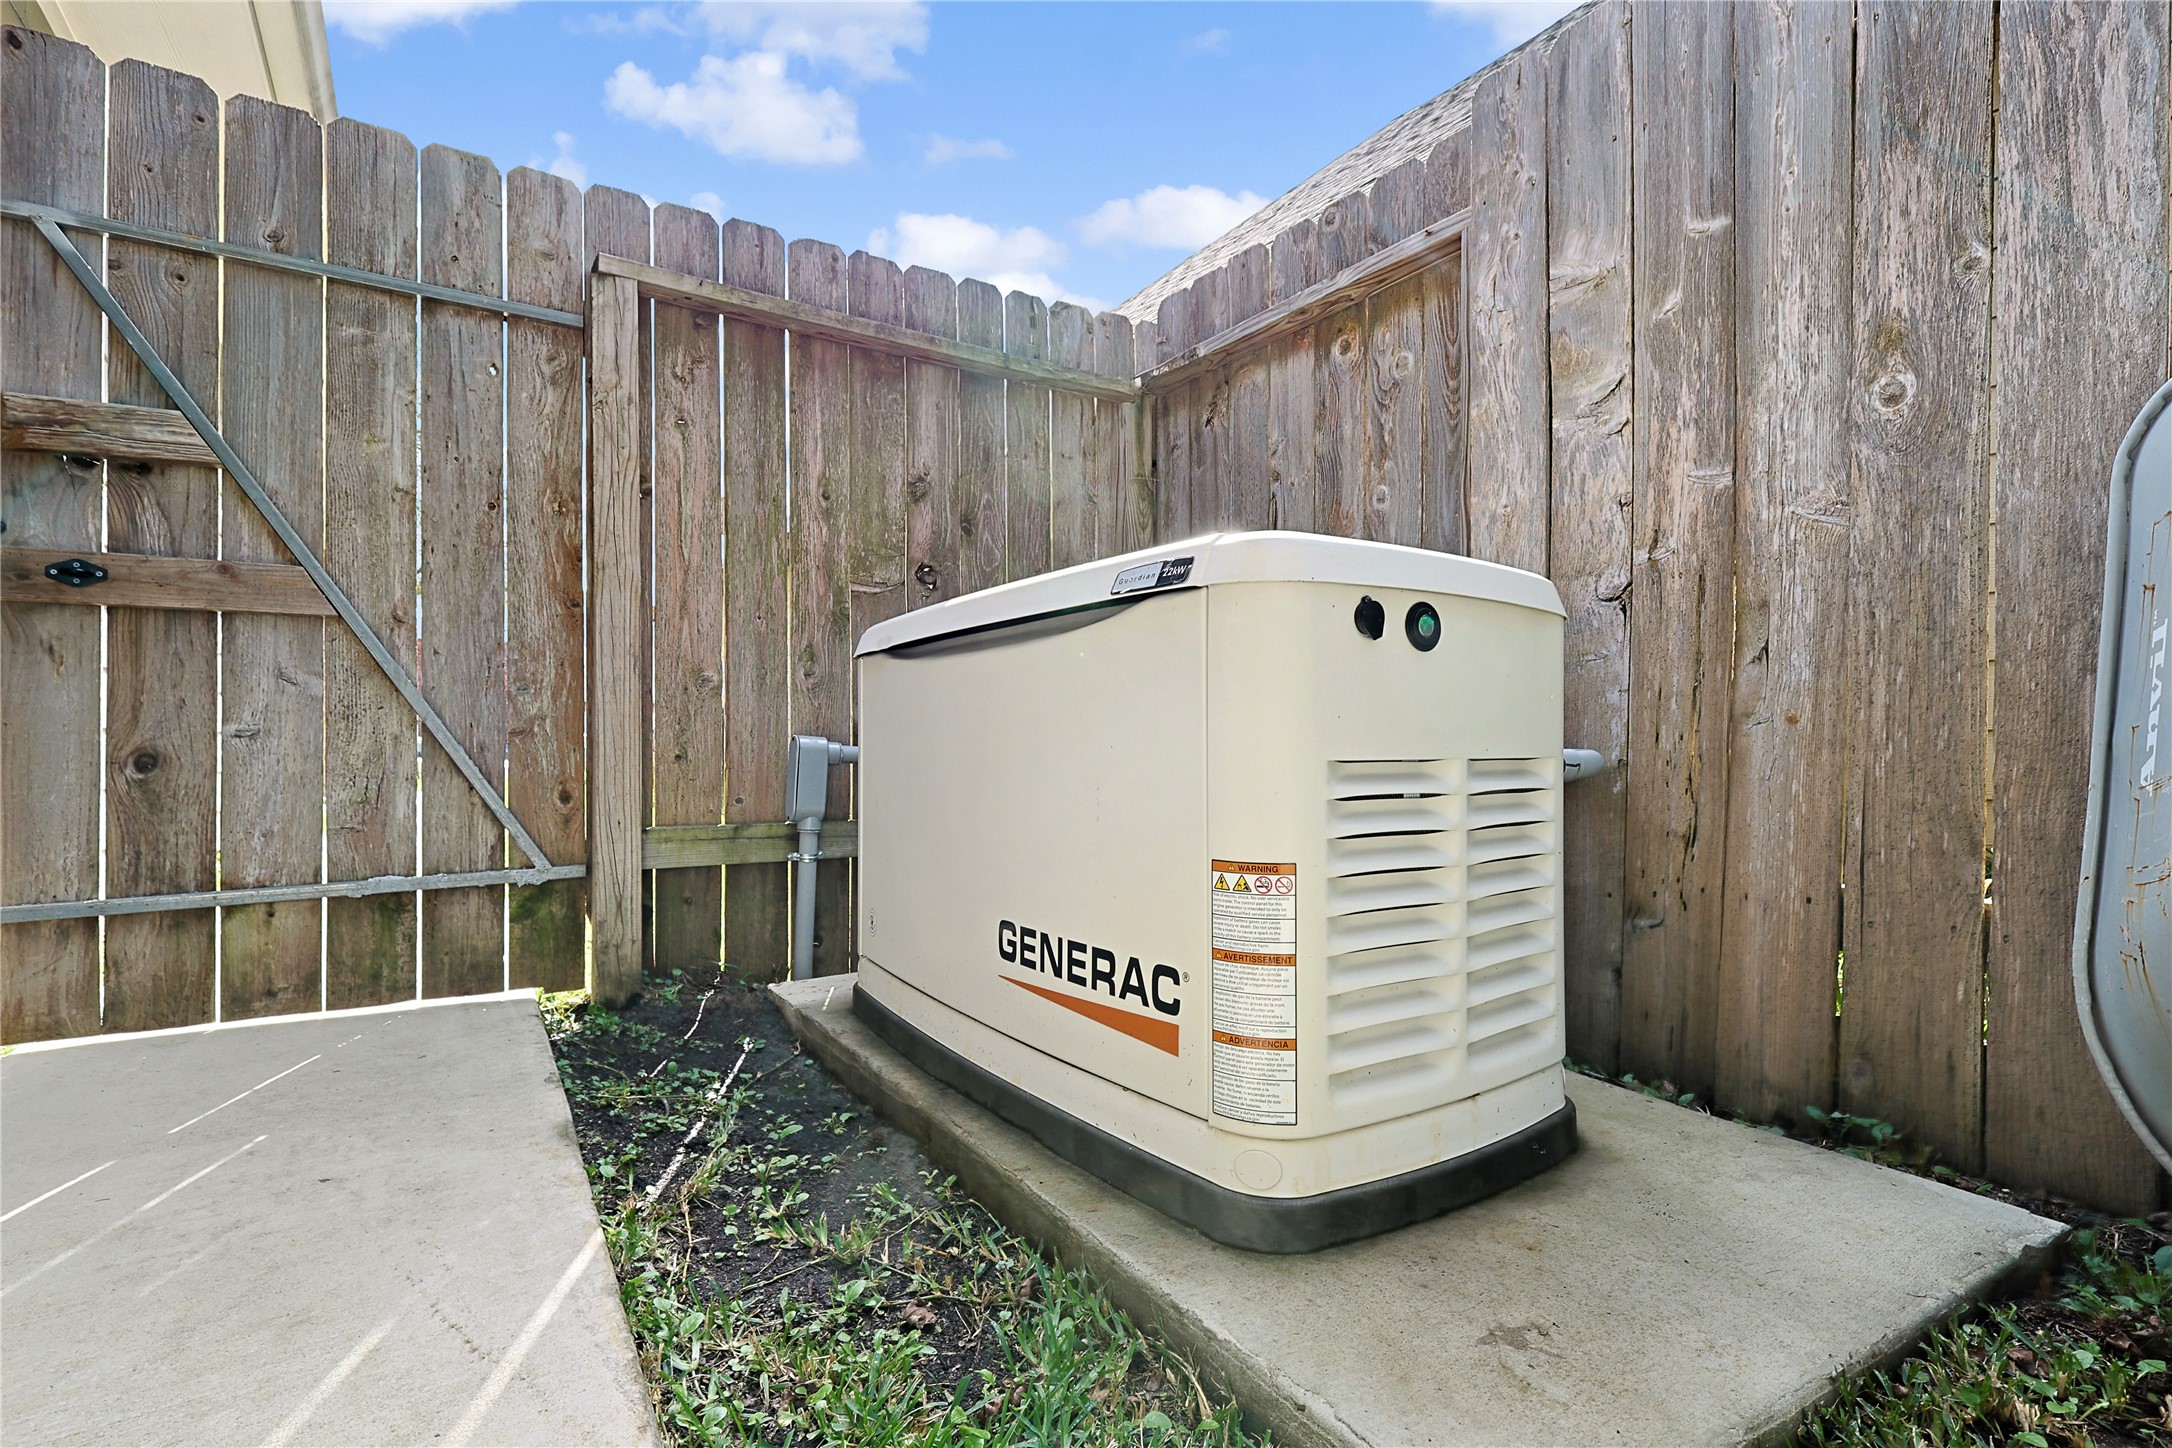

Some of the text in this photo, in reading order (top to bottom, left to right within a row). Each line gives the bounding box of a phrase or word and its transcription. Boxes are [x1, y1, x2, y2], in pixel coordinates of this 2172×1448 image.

[1119, 565, 1187, 585] Guardian 22kW
[2140, 618, 2168, 798] Anvil
[1238, 865, 1278, 873] WARNING
[1224, 952, 1293, 964] AVERTISSEMENT
[1229, 1036, 1288, 1048] ADVERTENCIA
